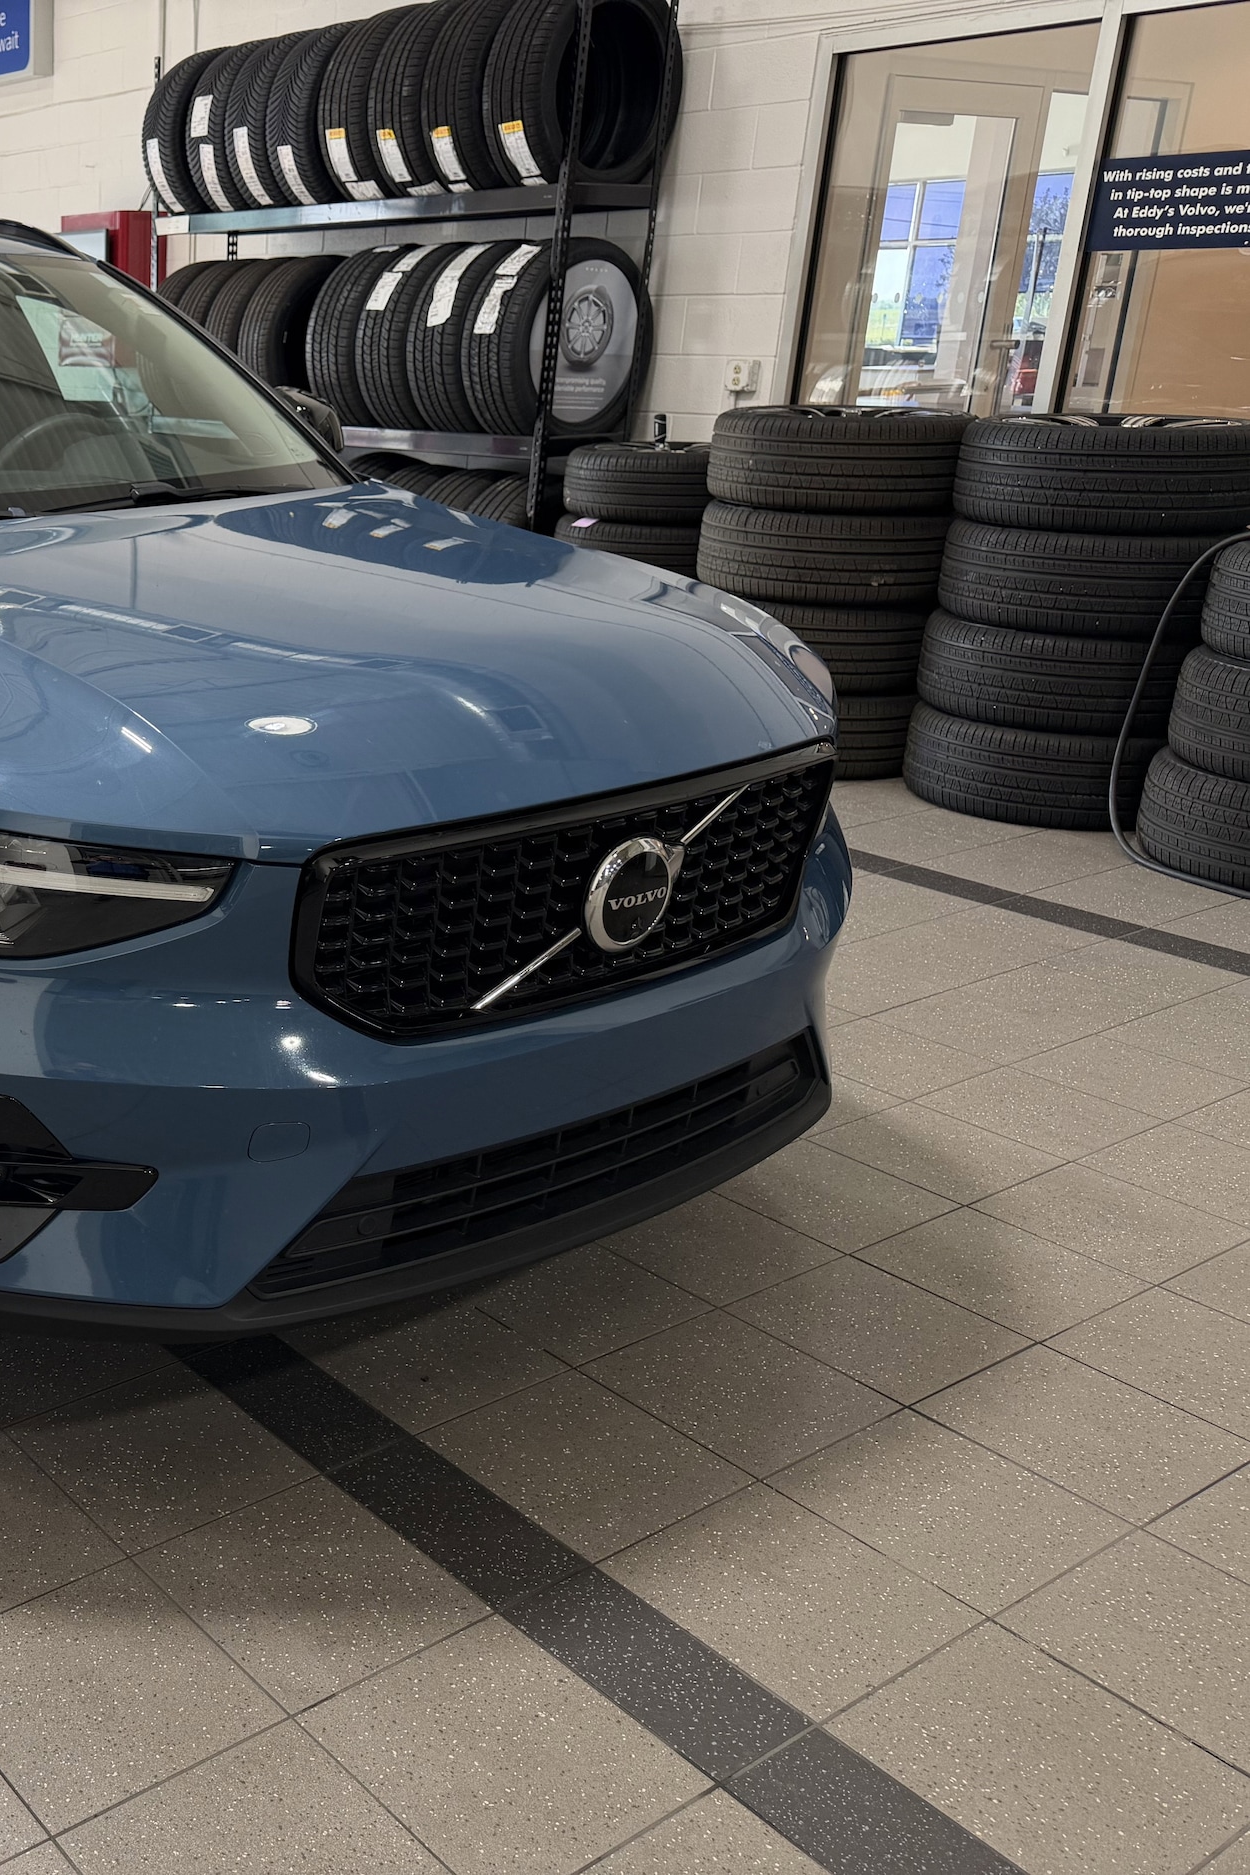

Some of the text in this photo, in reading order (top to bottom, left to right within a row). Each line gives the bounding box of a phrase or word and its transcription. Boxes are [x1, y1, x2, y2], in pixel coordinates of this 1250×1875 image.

[1103, 169, 1132, 182] With
[1135, 168, 1173, 182] rising
[1177, 166, 1211, 179] costs
[1213, 162, 1244, 177] and
[1110, 188, 1123, 201] in
[1126, 187, 1171, 202] tip-top
[1174, 184, 1217, 199] shape
[1220, 183, 1233, 195] is
[1113, 207, 1129, 219] At
[1131, 205, 1175, 220] Eddy's
[1179, 203, 1220, 217] Volvo,
[1113, 223, 1174, 239] thorough
[608, 886, 667, 911] VOLVO
